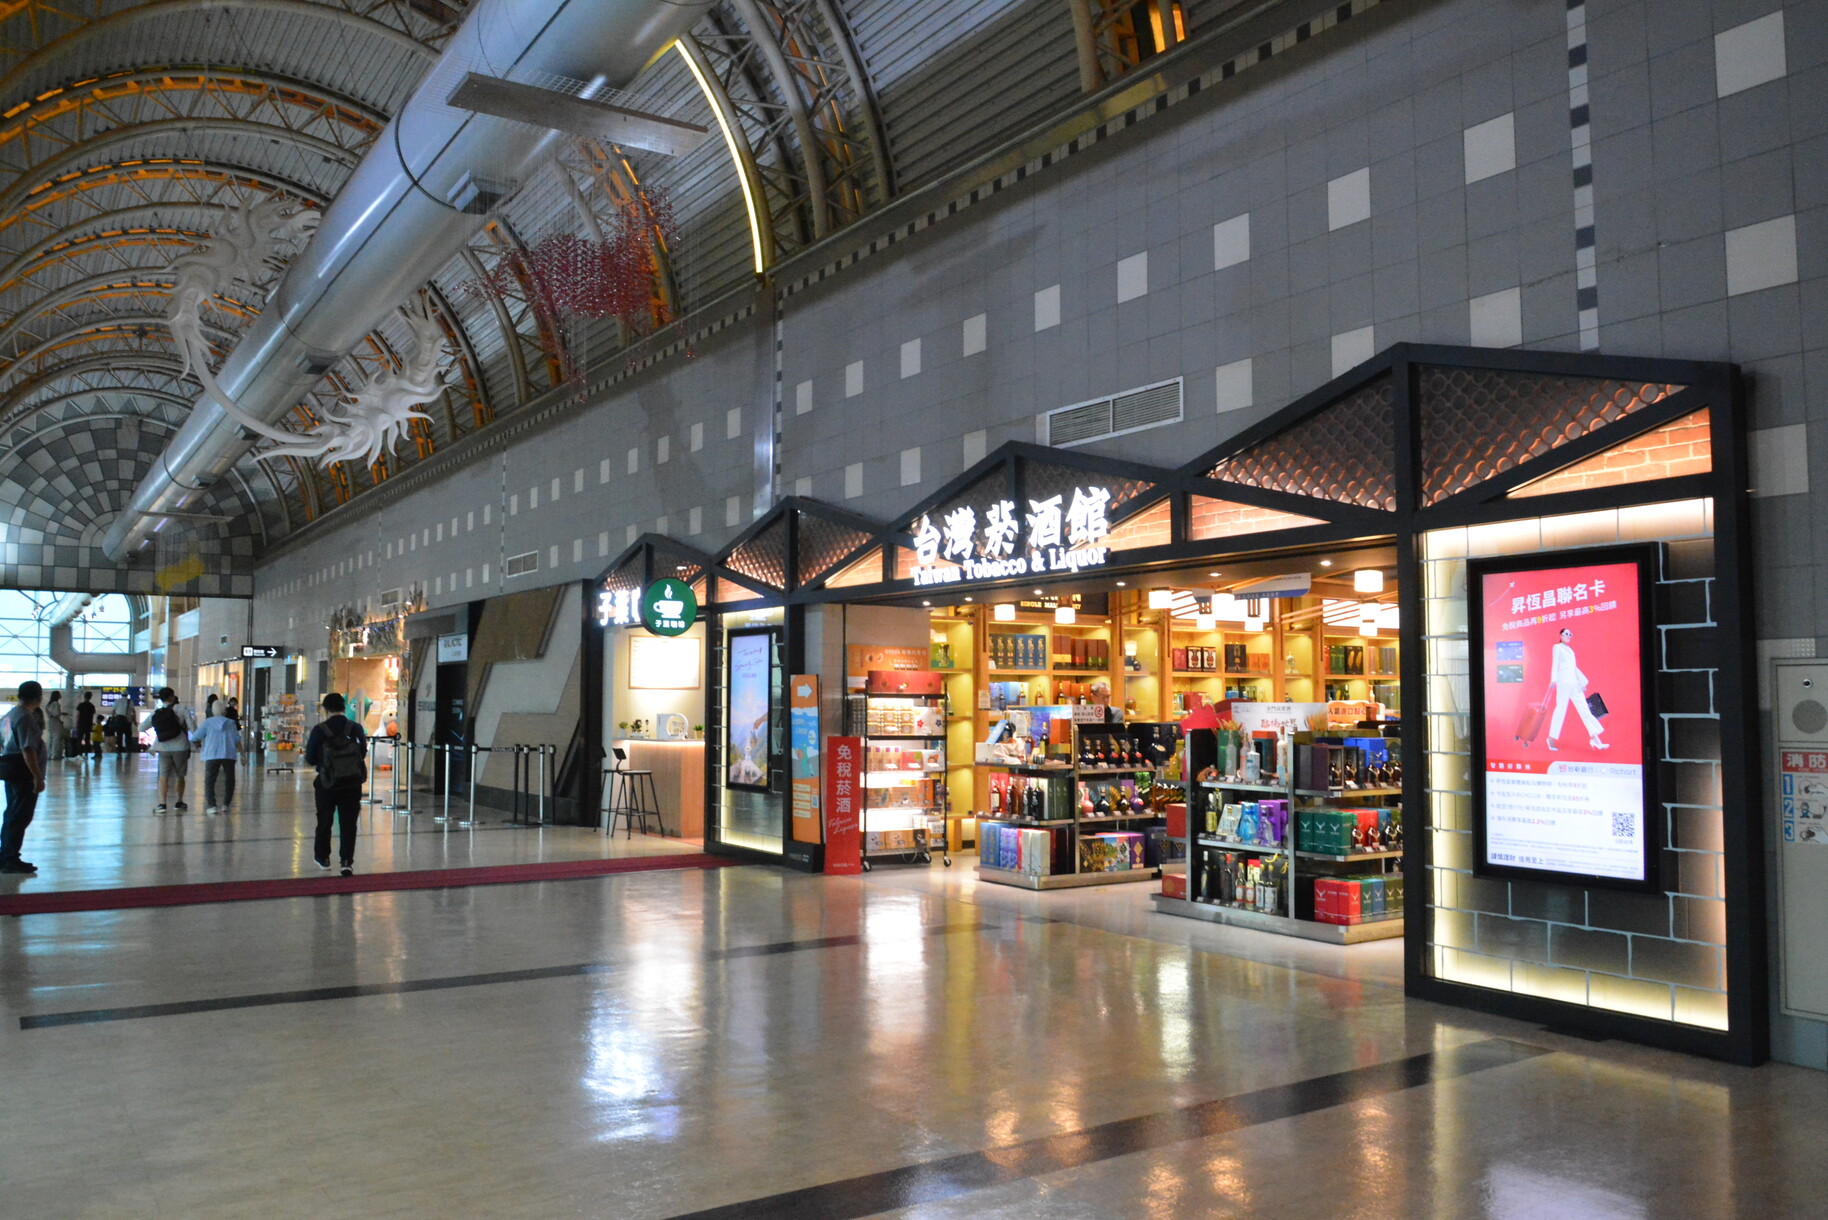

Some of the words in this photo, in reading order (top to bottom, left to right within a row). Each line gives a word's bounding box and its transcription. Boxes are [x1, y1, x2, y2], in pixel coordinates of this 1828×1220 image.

[913, 486, 1111, 565] 台灣菸酒館
[910, 565, 961, 586] Taiwan
[963, 556, 1027, 580] Tobacco
[1031, 552, 1046, 572] &
[1049, 547, 1107, 573] Liquor
[1511, 579, 1606, 615] 昇恆昌聯名卡
[1609, 767, 1637, 776] Richart
[1786, 753, 1826, 769] 消防
[836, 744, 852, 814] 免稅菸酒
[1785, 776, 1791, 794] 1
[1784, 799, 1793, 817] 2
